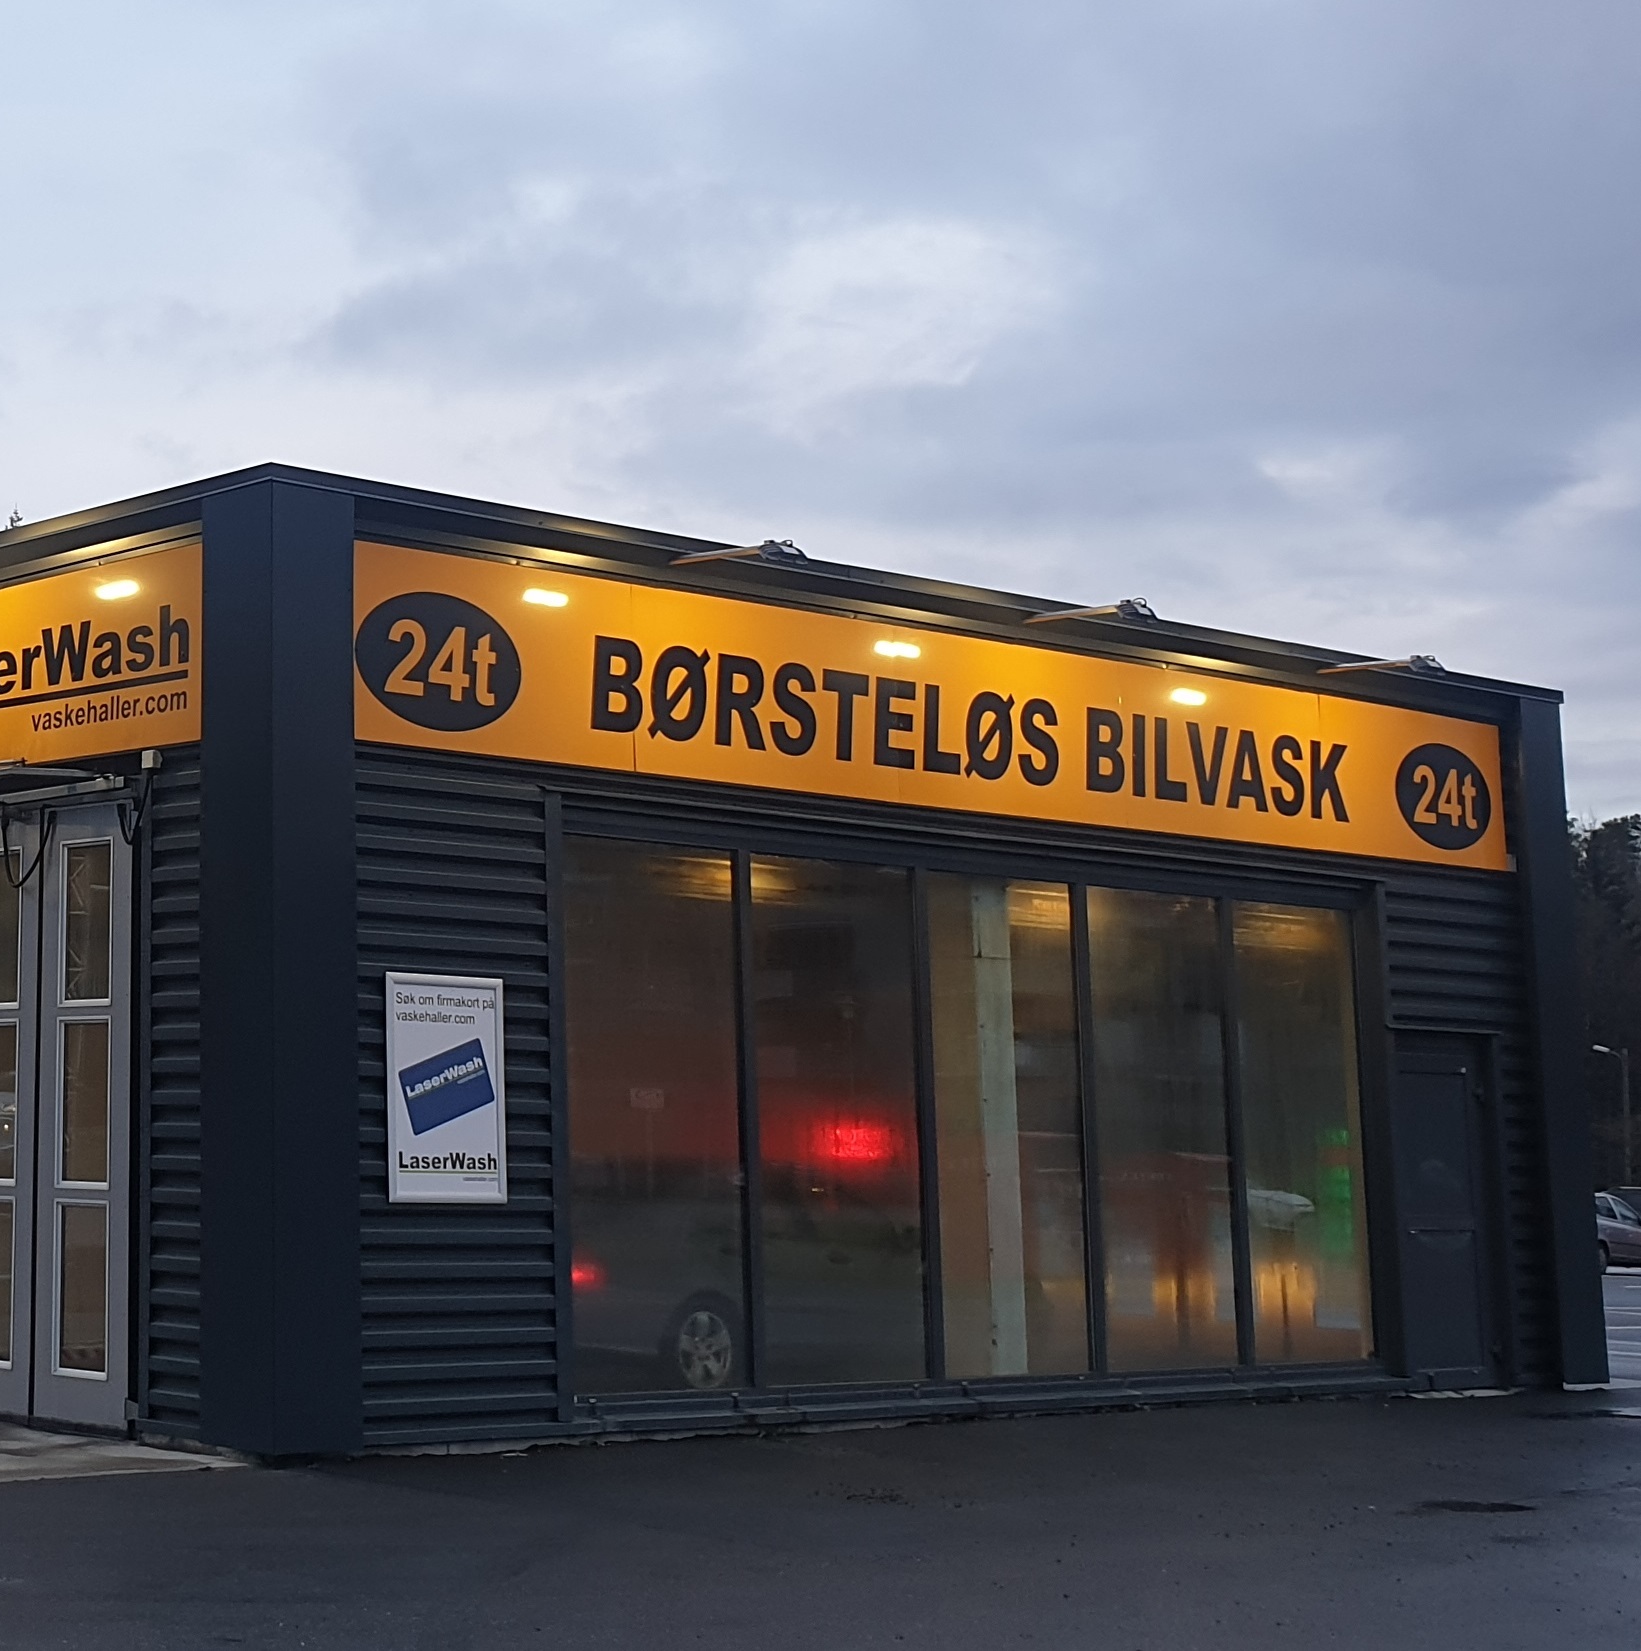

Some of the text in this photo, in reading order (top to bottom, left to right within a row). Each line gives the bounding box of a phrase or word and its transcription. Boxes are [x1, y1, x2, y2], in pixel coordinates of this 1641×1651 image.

[384, 618, 496, 706] 24t
[31, 689, 188, 732] vaskehaller.com
[590, 634, 1350, 823] BØRSTELØS BILVASK
[1412, 765, 1478, 830] 24t
[395, 991, 416, 1005] Søk
[418, 995, 434, 1006] om
[437, 993, 480, 1009] firmakort
[395, 1010, 476, 1025] vaskehaller.com
[405, 1056, 484, 1098] LaserWash
[398, 1150, 498, 1170] LaserWash
